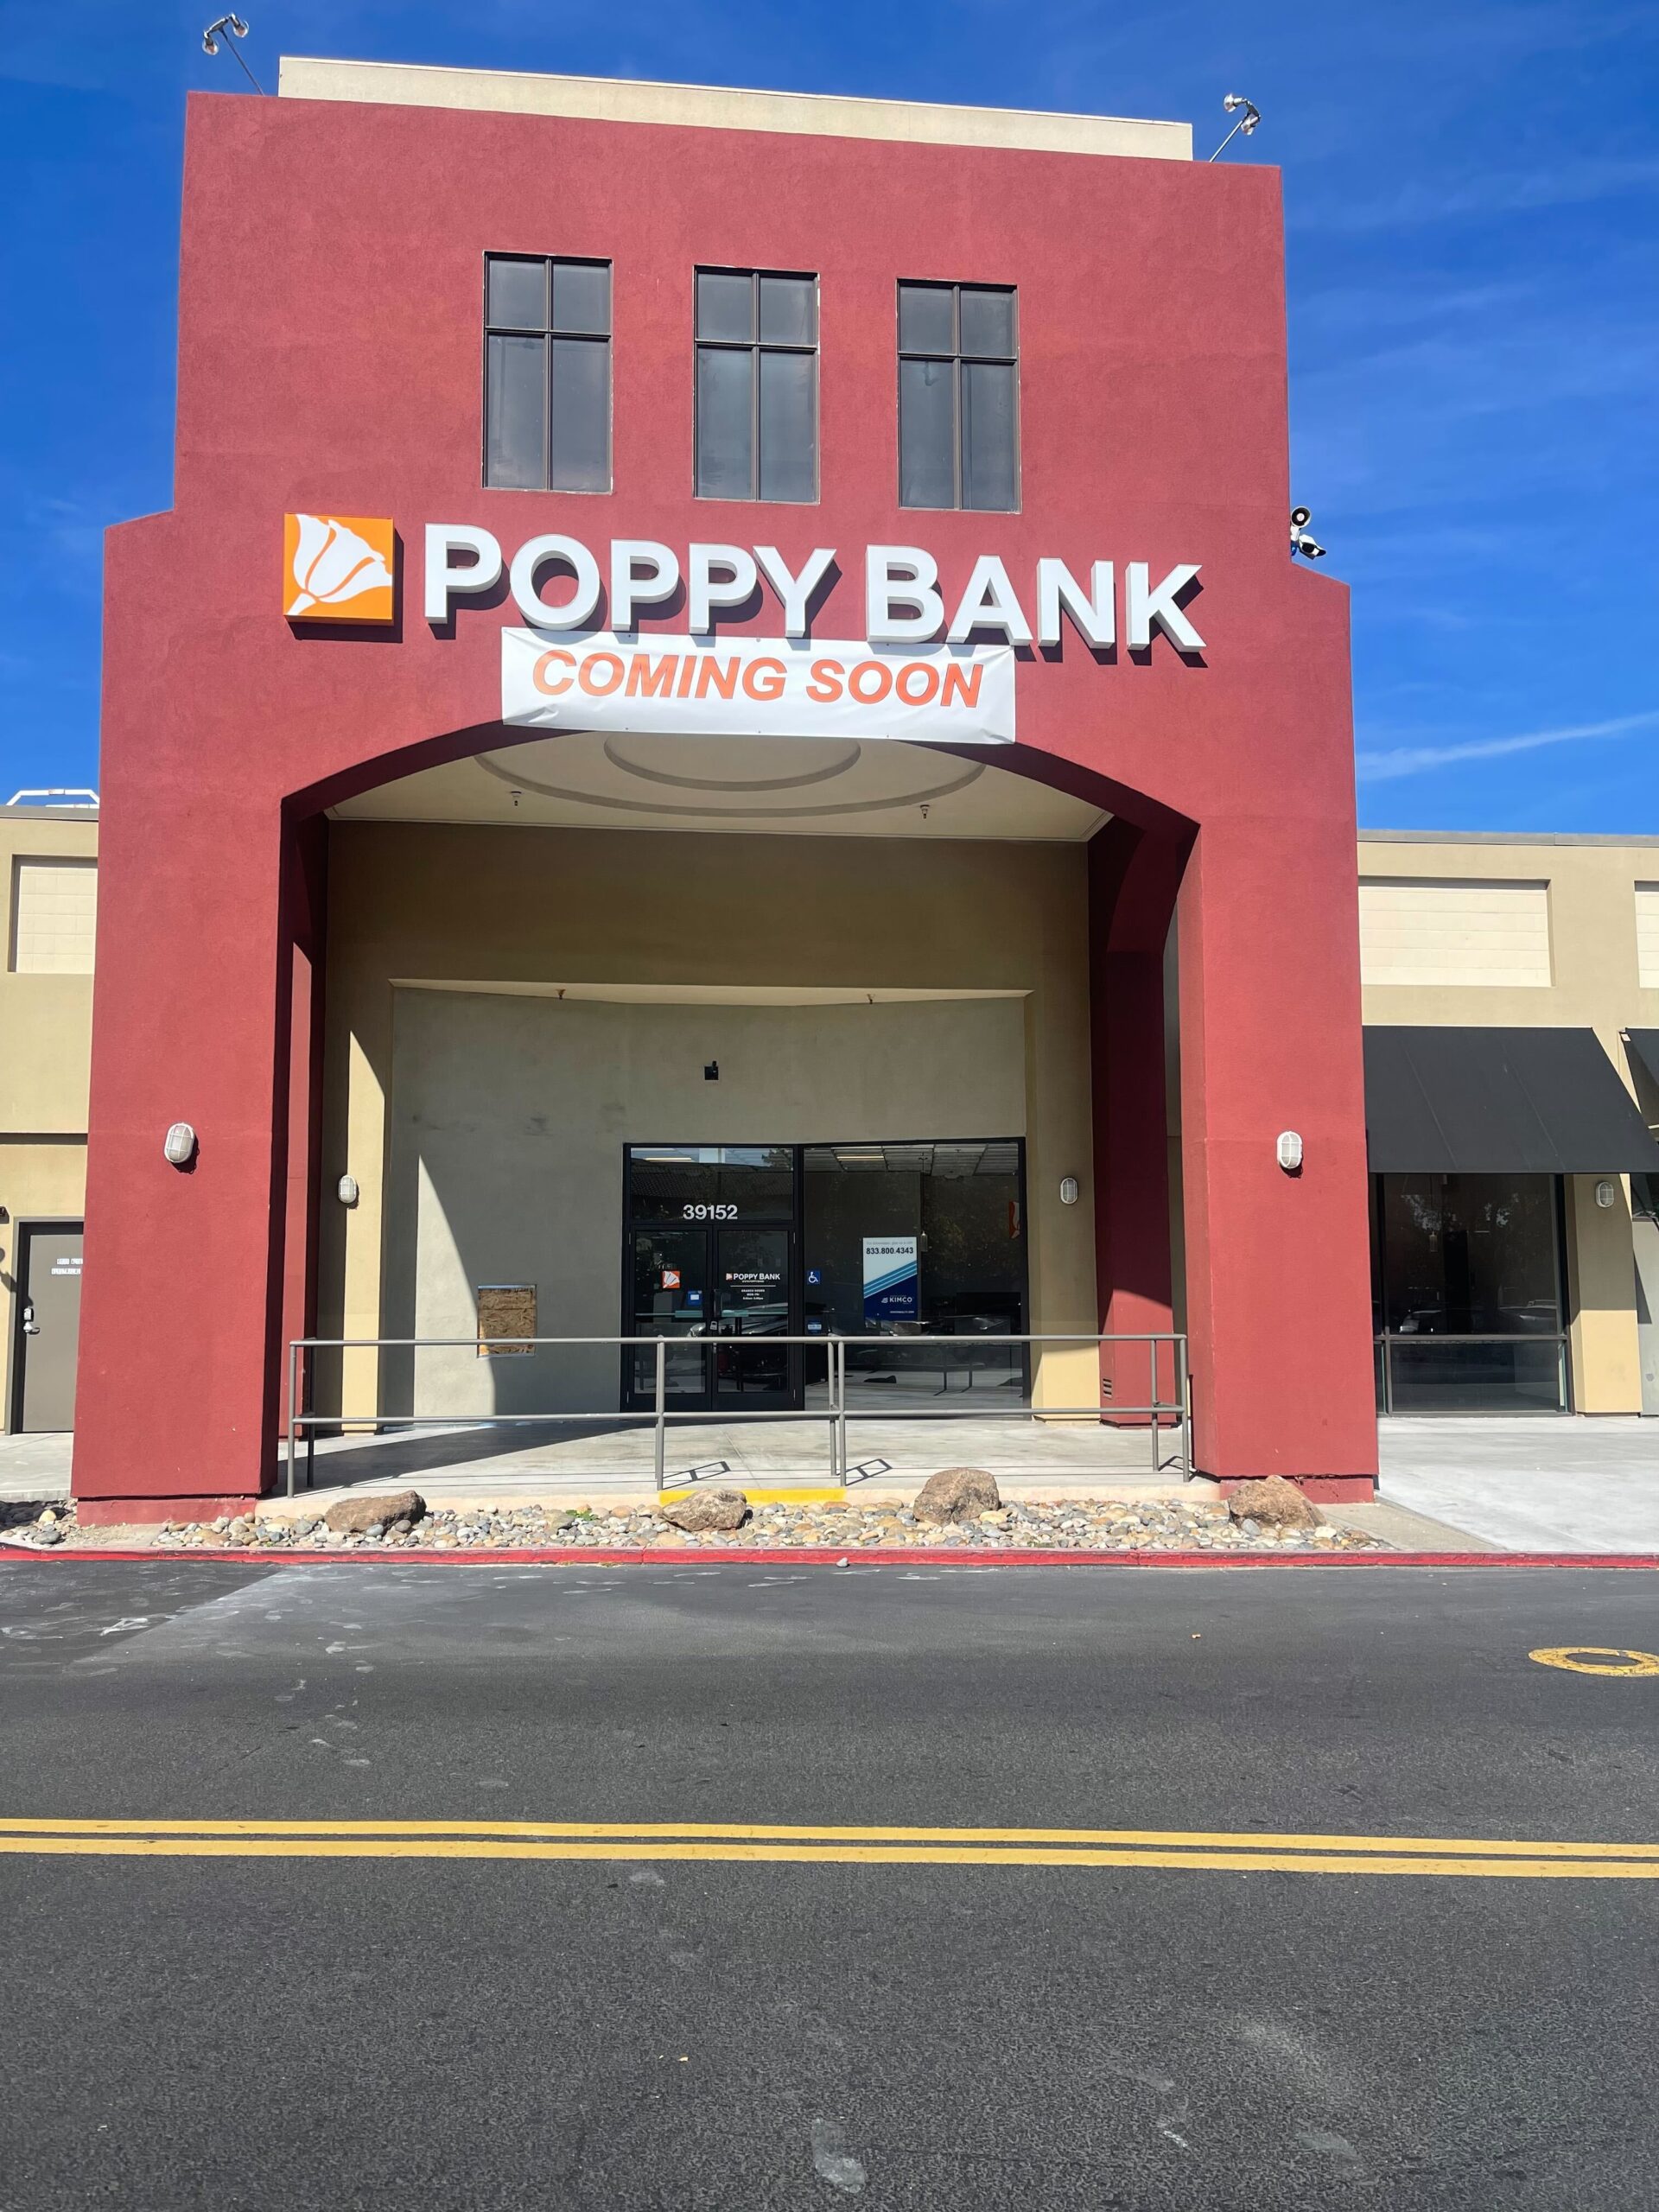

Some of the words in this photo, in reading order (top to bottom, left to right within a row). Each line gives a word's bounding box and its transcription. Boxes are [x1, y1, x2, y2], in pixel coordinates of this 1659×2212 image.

[423, 523, 837, 638] POPPY
[865, 544, 1205, 652] BANK
[533, 650, 786, 700] COMING
[806, 659, 982, 707] SOON
[683, 1205, 738, 1219] 39152
